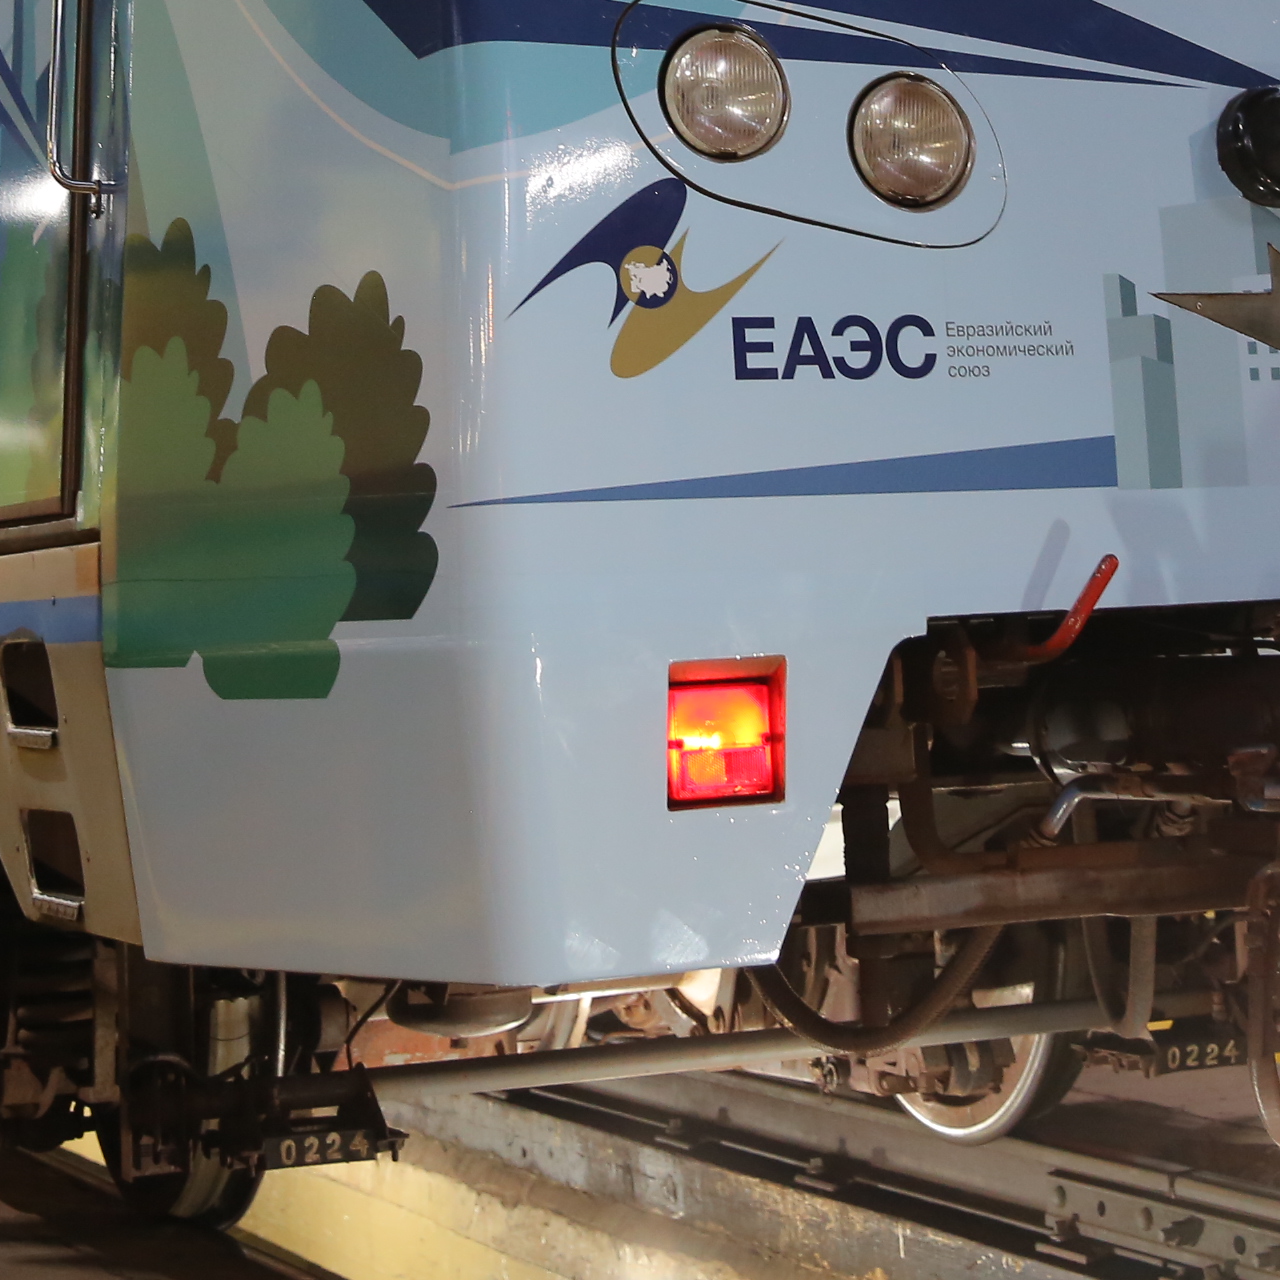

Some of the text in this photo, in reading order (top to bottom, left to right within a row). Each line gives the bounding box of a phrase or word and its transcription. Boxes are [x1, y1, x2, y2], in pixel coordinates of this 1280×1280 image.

[945, 320, 1053, 340] Евразийский
[731, 314, 938, 381] ЕАЭС
[946, 339, 1075, 357] экономический
[948, 365, 991, 377] союз
[1167, 1039, 1239, 1070] 0224
[280, 1129, 370, 1166] 0224
